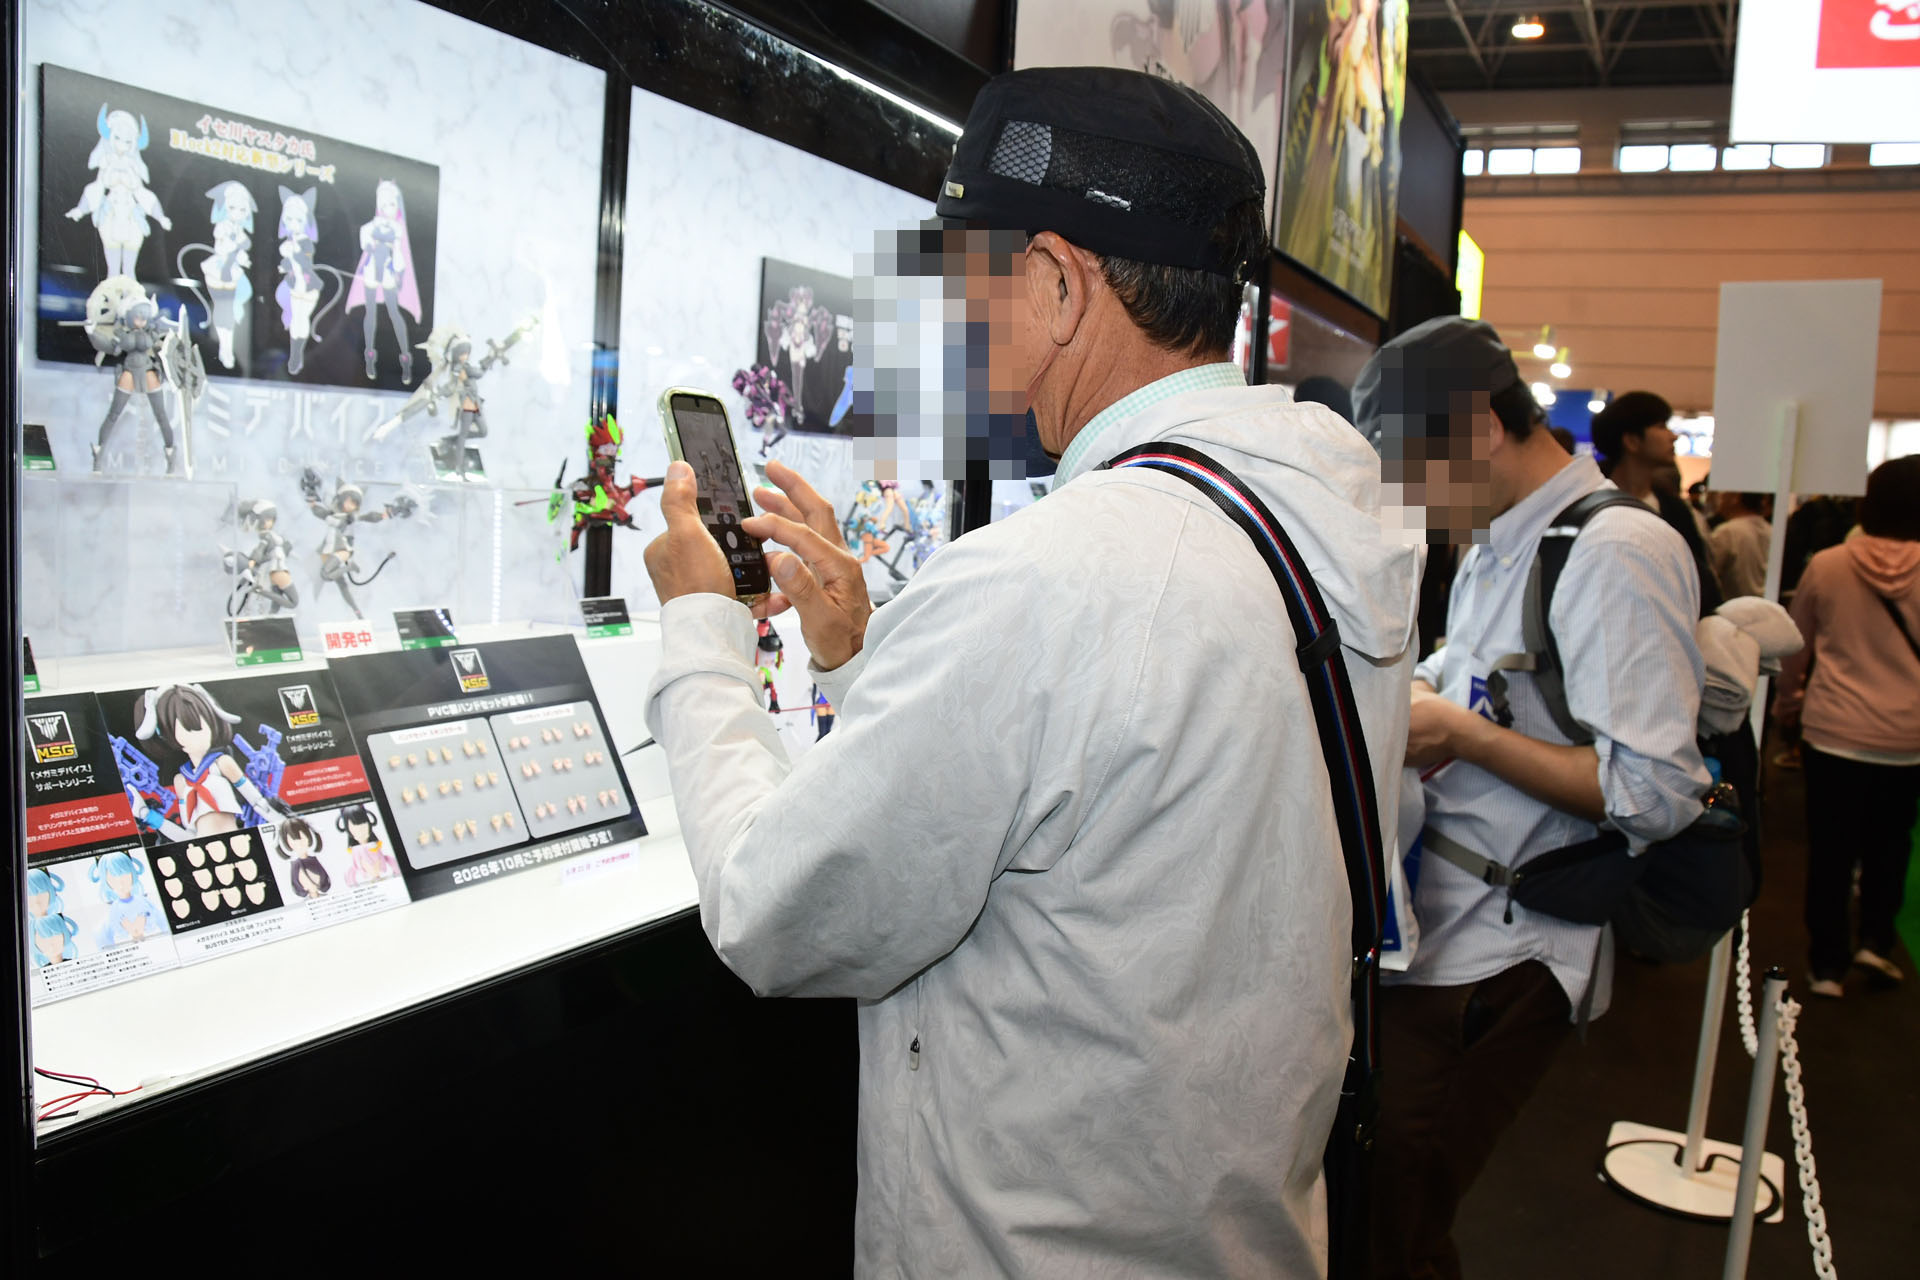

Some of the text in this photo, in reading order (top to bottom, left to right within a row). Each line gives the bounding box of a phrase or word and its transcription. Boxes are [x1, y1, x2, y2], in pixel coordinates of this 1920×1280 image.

[325, 630, 372, 650] 開発中
[30, 764, 92, 780] 「メガミデバイス」
[35, 775, 95, 792] サポートシリーズ
